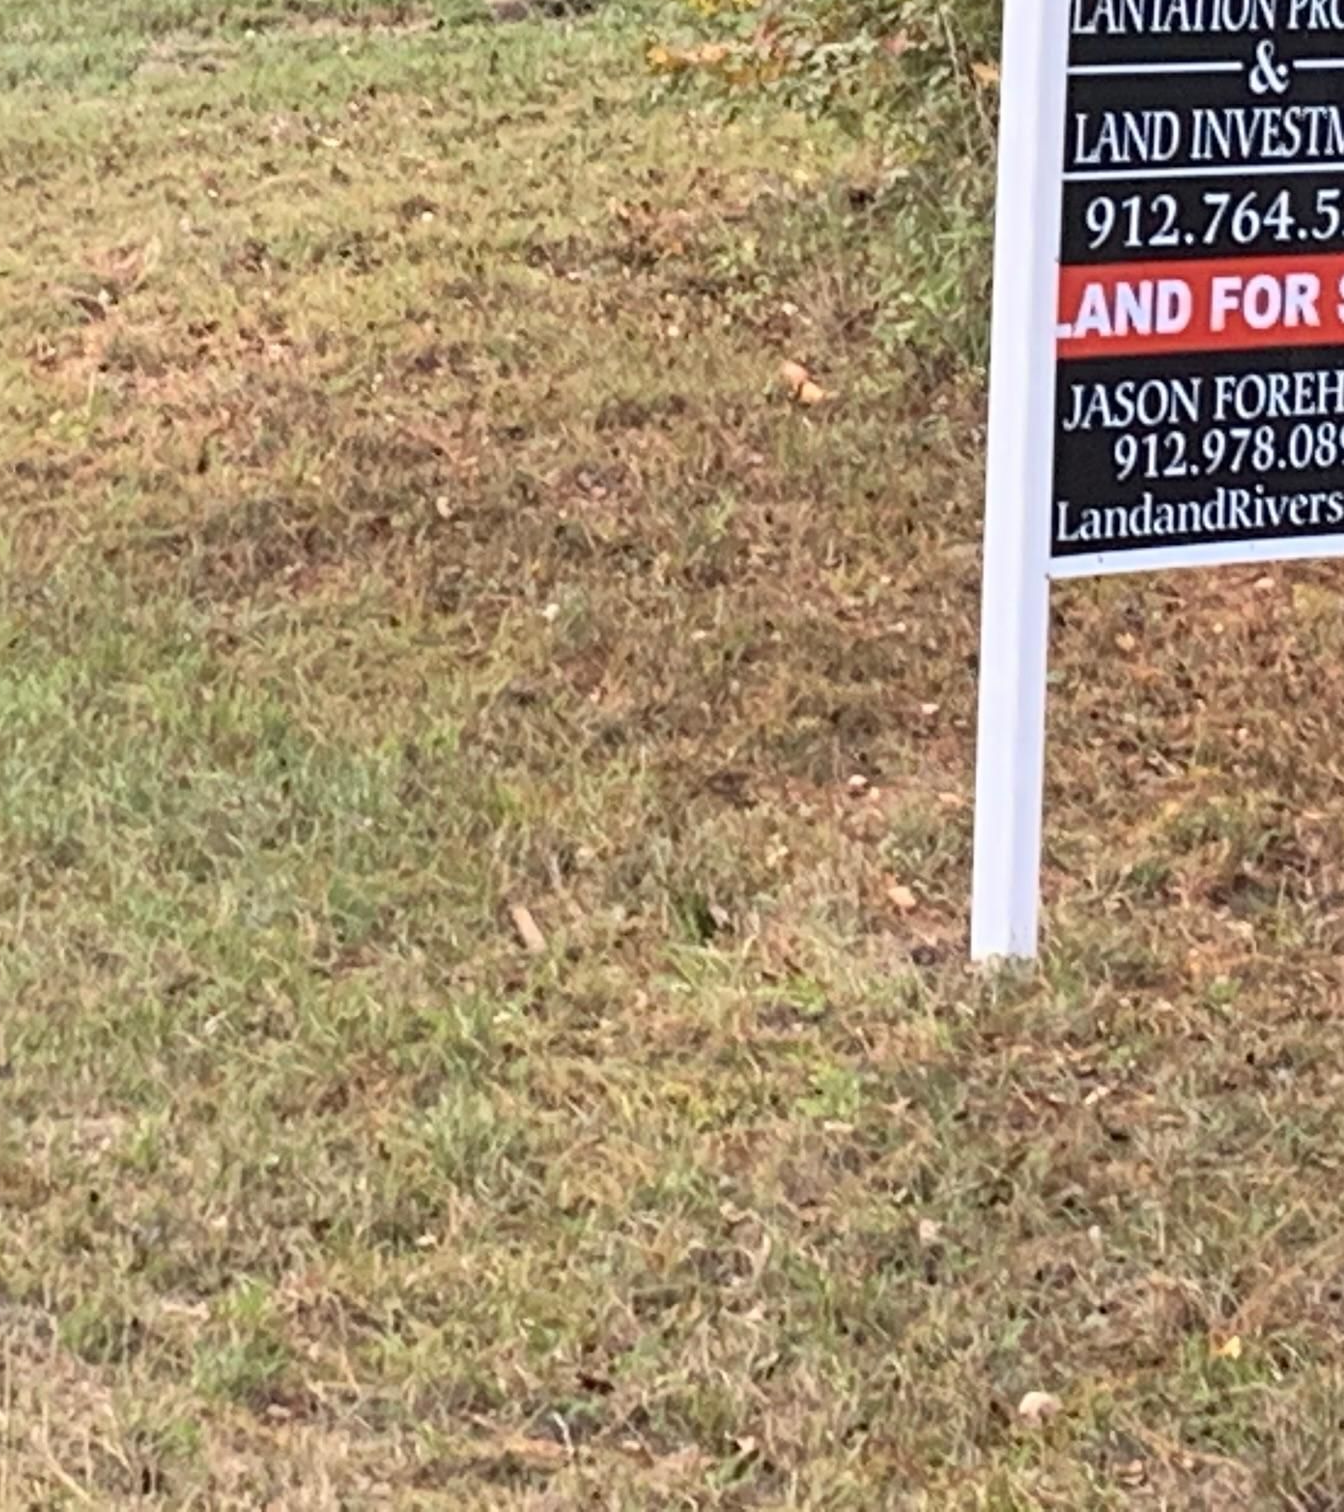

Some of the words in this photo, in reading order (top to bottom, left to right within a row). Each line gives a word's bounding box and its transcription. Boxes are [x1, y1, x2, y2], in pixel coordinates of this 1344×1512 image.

[1248, 39, 1290, 94] &
[1074, 110, 1179, 164] LAND
[1055, 278, 1193, 339] AND
[1210, 271, 1321, 332] FOR
[1063, 377, 1202, 432] JASON
